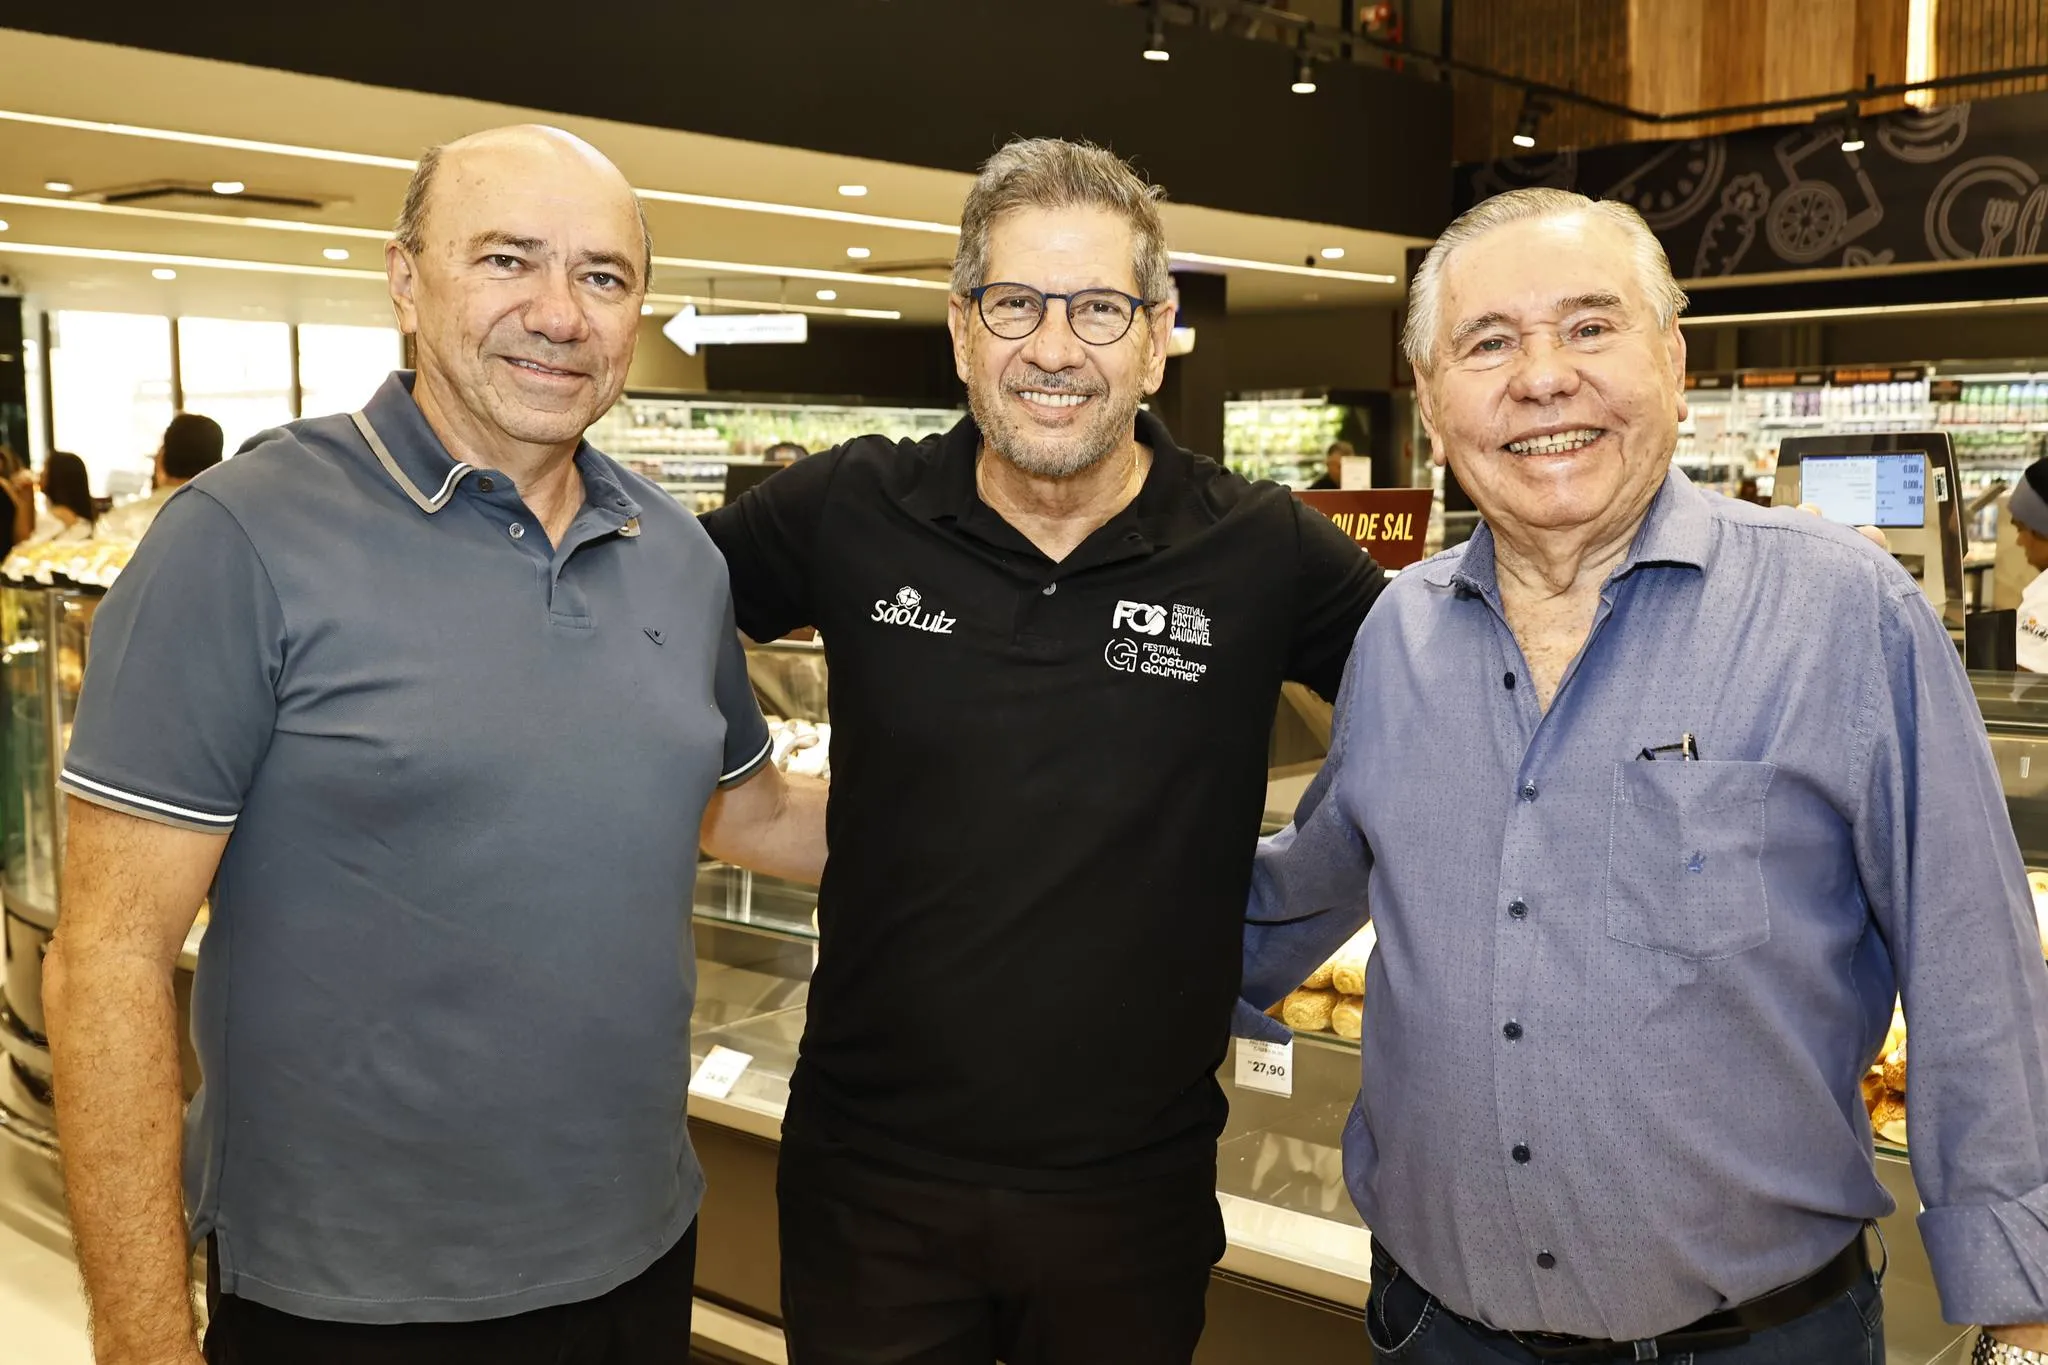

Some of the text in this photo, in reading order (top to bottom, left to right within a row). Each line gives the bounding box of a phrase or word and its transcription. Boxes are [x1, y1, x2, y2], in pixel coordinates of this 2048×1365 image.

[1355, 513, 1380, 541] DE
[1381, 513, 1413, 541] SAL
[1172, 603, 1206, 618] FESTIVAL
[1171, 611, 1212, 632] COSTUME
[1142, 642, 1181, 657] FESTIVAL
[1140, 661, 1201, 683] Gourmet
[1149, 652, 1207, 674] Costume
[1252, 1060, 1285, 1077] 27,90
